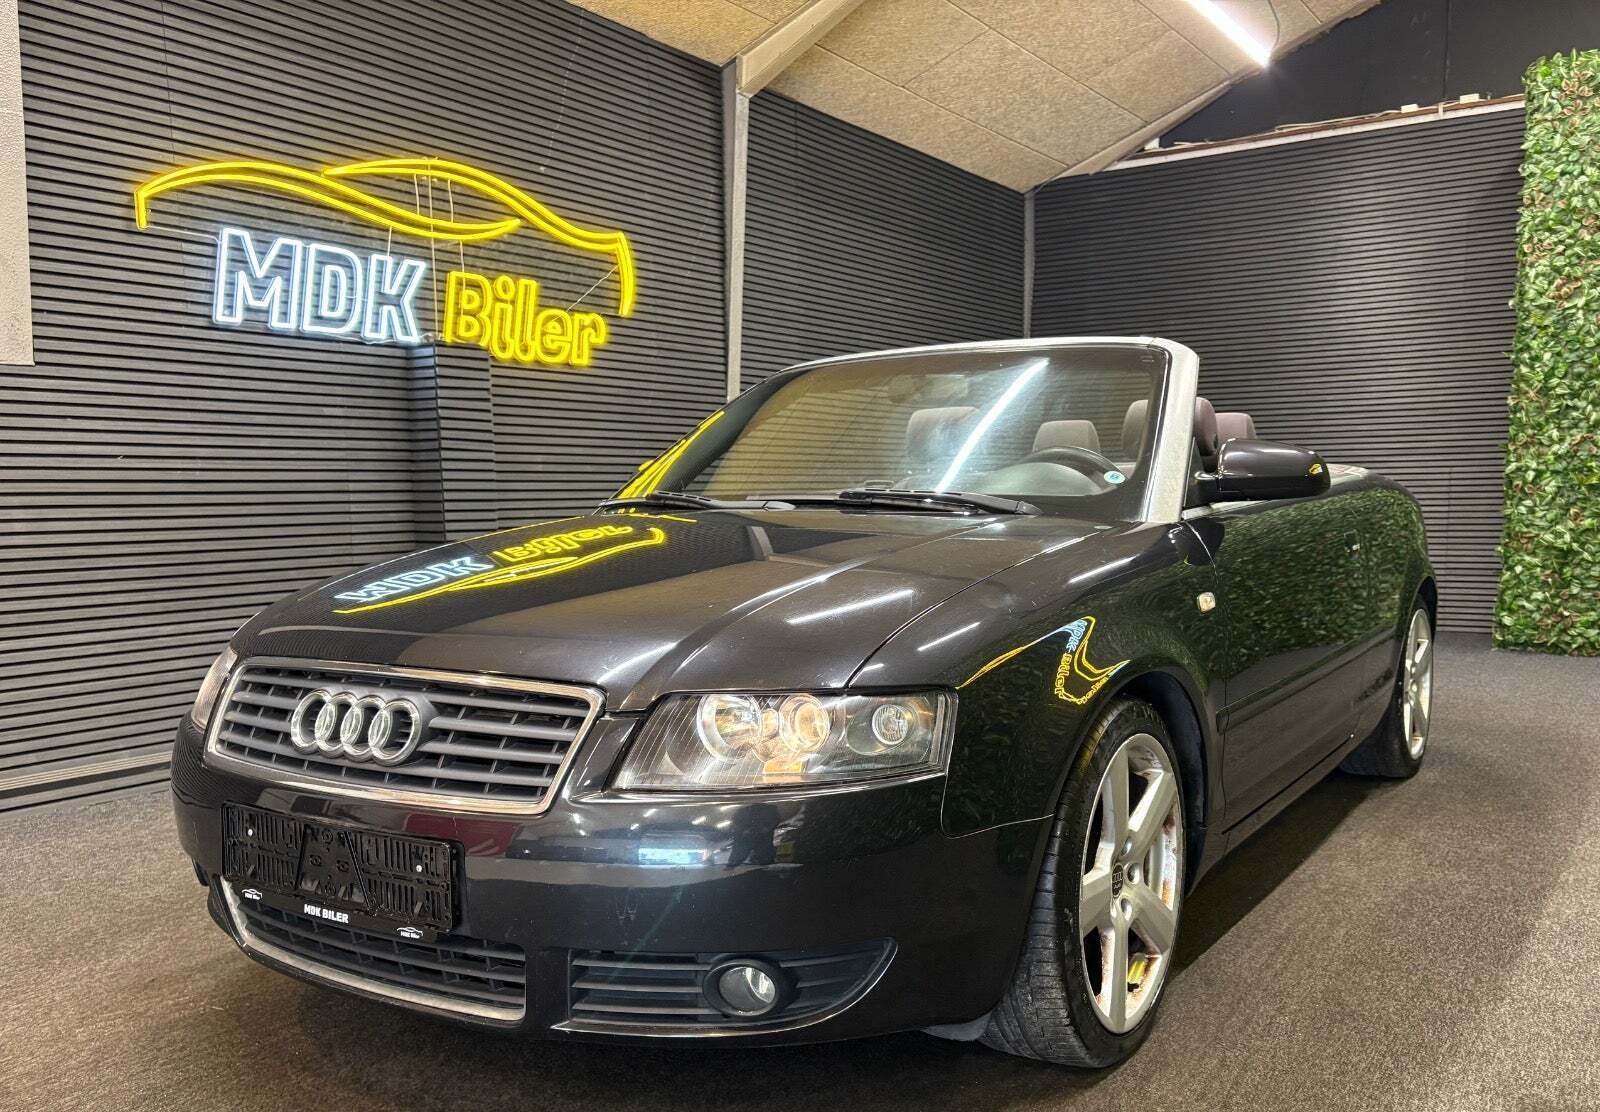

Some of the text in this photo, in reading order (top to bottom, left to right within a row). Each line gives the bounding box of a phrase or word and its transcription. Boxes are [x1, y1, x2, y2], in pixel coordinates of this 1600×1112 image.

[213, 227, 608, 366] MDK Biler
[303, 903, 349, 924] MDK BILER
